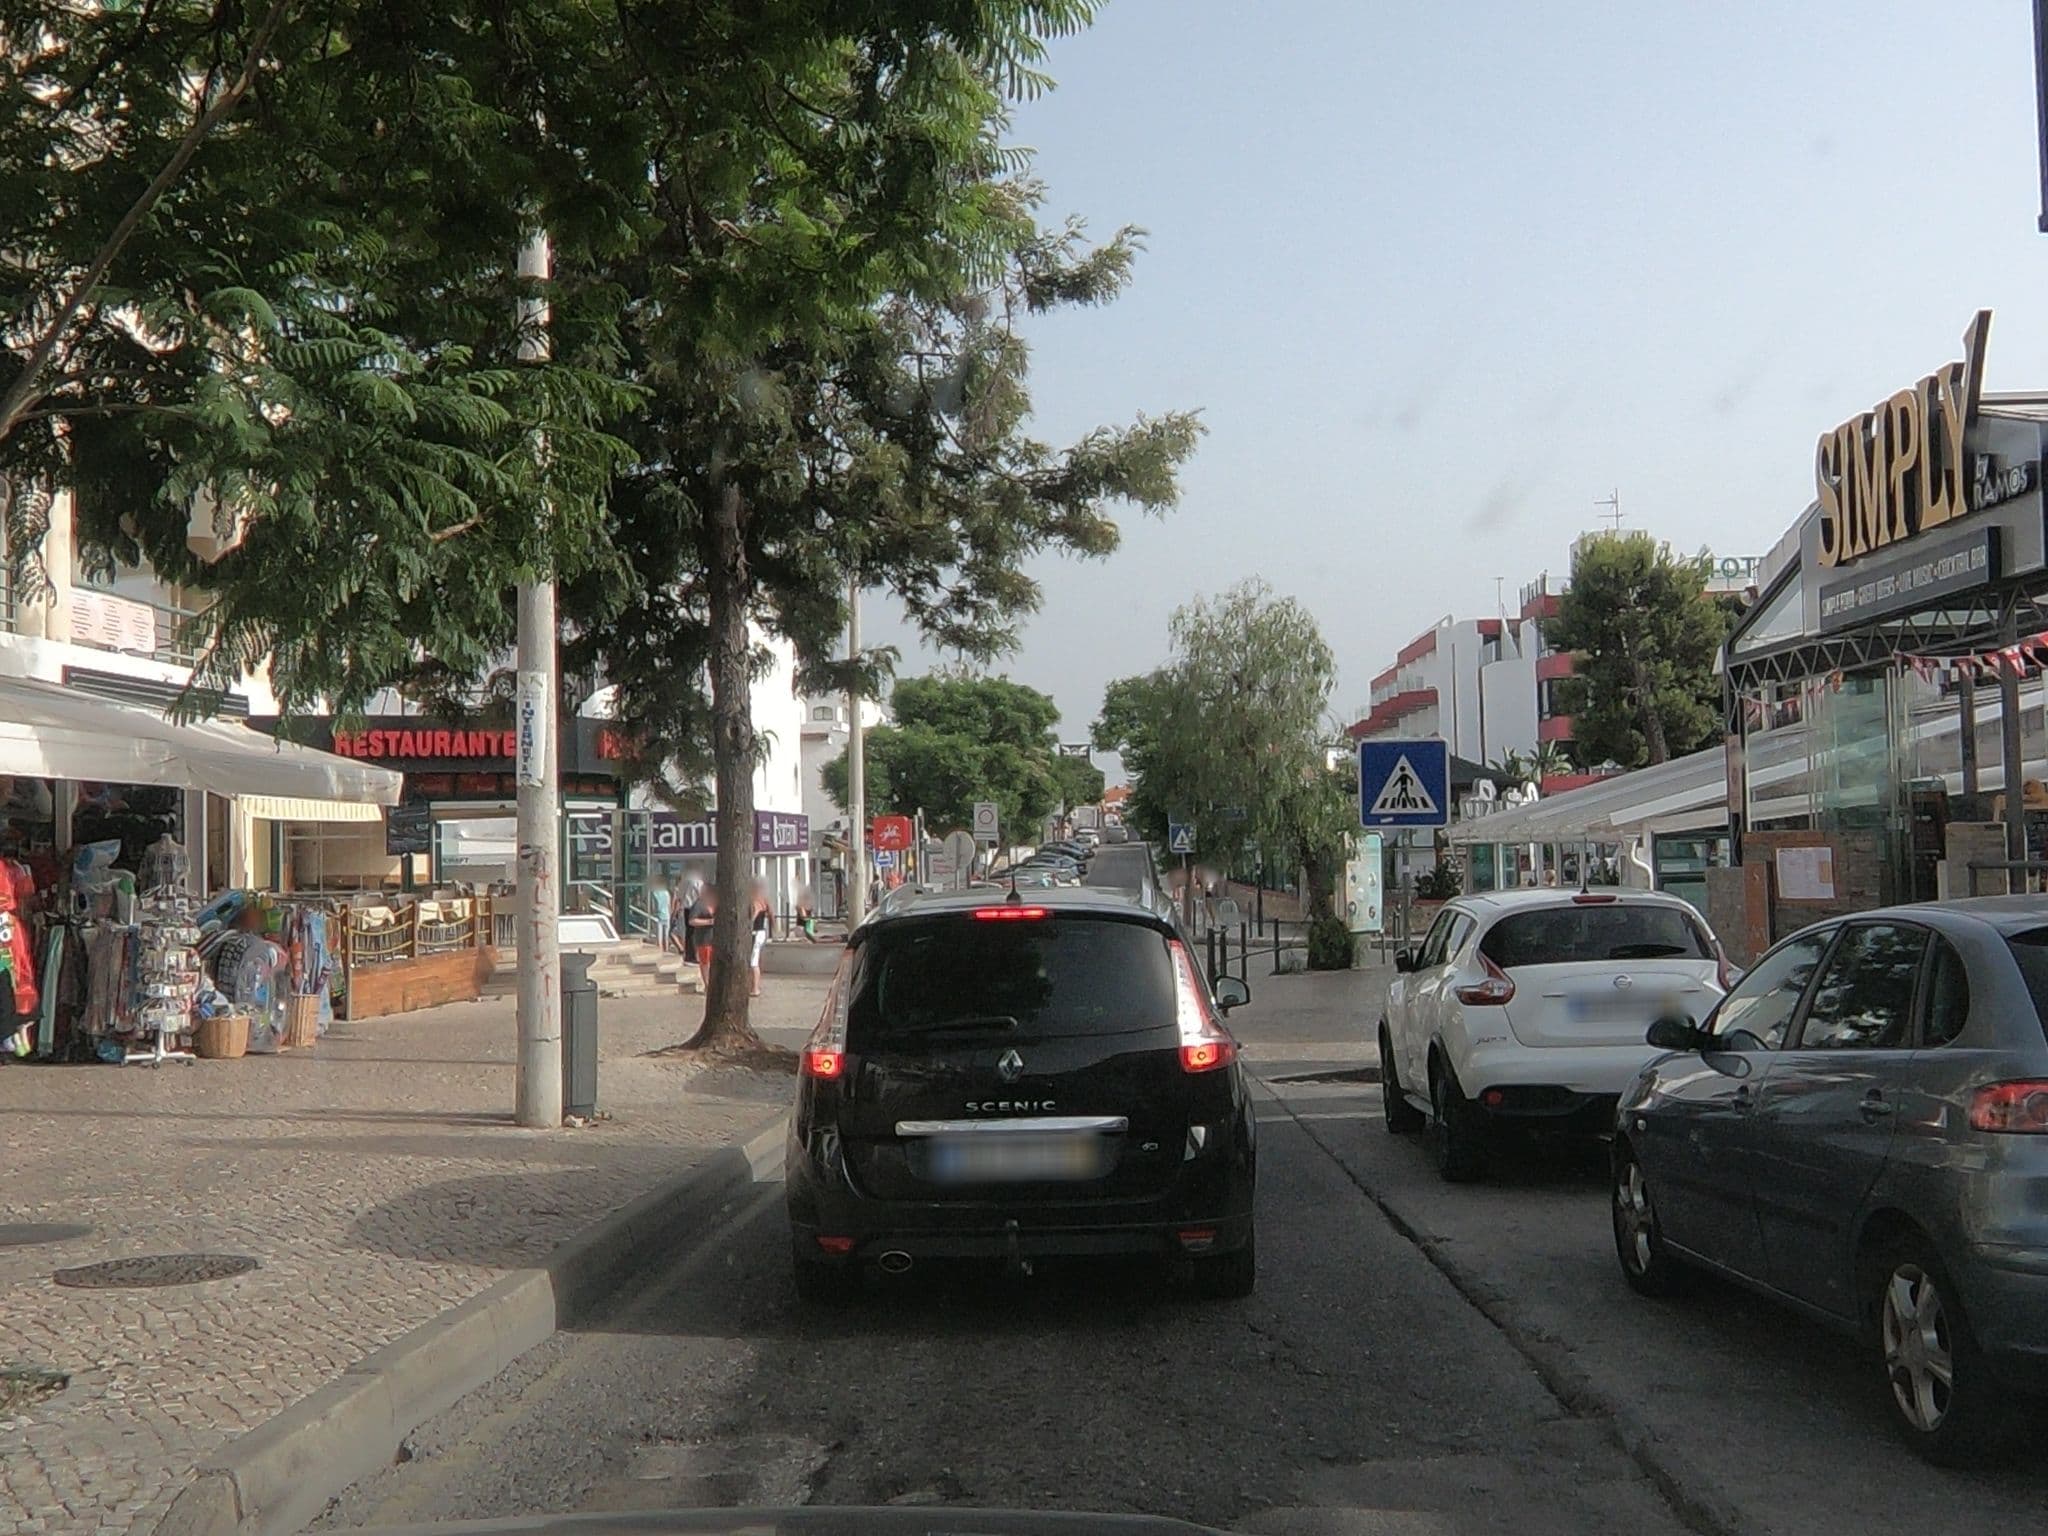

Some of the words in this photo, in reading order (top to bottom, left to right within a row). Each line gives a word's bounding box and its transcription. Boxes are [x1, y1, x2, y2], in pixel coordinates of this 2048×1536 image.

[1817, 308, 1992, 567] SIMPLY
[334, 730, 516, 757] RESTAURANTE
[596, 817, 718, 849] srtami
[966, 1100, 1056, 1113] SCENIC
